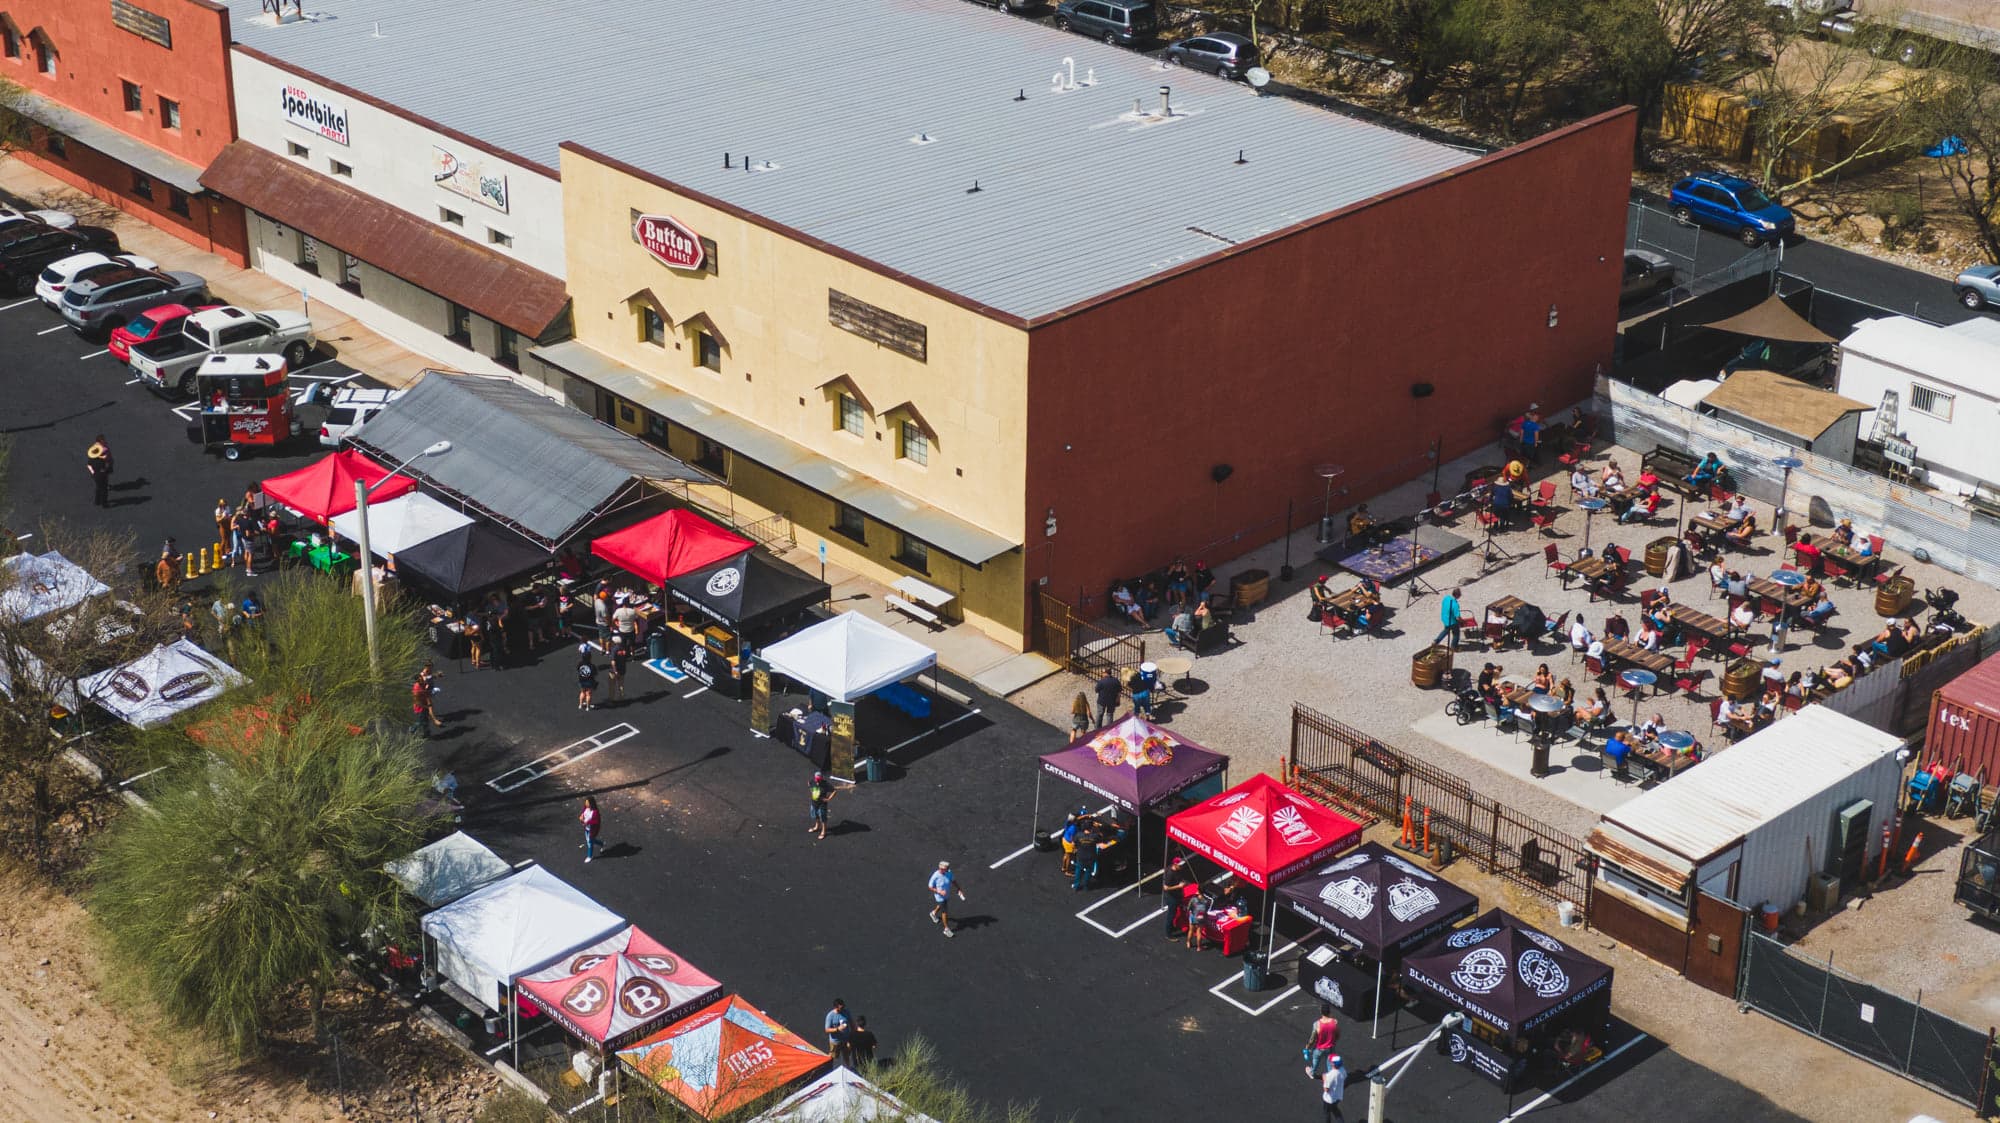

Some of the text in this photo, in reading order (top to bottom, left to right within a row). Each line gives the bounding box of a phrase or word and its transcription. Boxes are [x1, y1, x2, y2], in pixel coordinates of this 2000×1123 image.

[287, 85, 307, 100] USED
[282, 87, 345, 133] Sportbike
[321, 126, 345, 144] PARTS
[644, 219, 692, 255] Button
[647, 238, 666, 254] BREW
[681, 659, 701, 677] COPPER
[700, 670, 715, 687] MINE
[1941, 708, 1970, 731] tex
[1044, 763, 1134, 811] CATALINA BREWING CO.
[1169, 825, 1212, 855] FIRETRUCK
[1212, 848, 1249, 876] BREWING
[1249, 870, 1264, 884] CO.
[1293, 901, 1364, 950] Tombstone Brewing Company
[1464, 950, 1503, 967] BLACKROCK
[1464, 965, 1499, 975] BRB
[1461, 974, 1499, 988] BREWERS
[567, 981, 602, 1012] B
[625, 985, 661, 1015] B
[1409, 967, 1510, 1031] BLACKROCK BREWERS
[1525, 976, 1609, 1030] BLACKROCK BREWERS
[723, 1040, 773, 1076] TEN55
